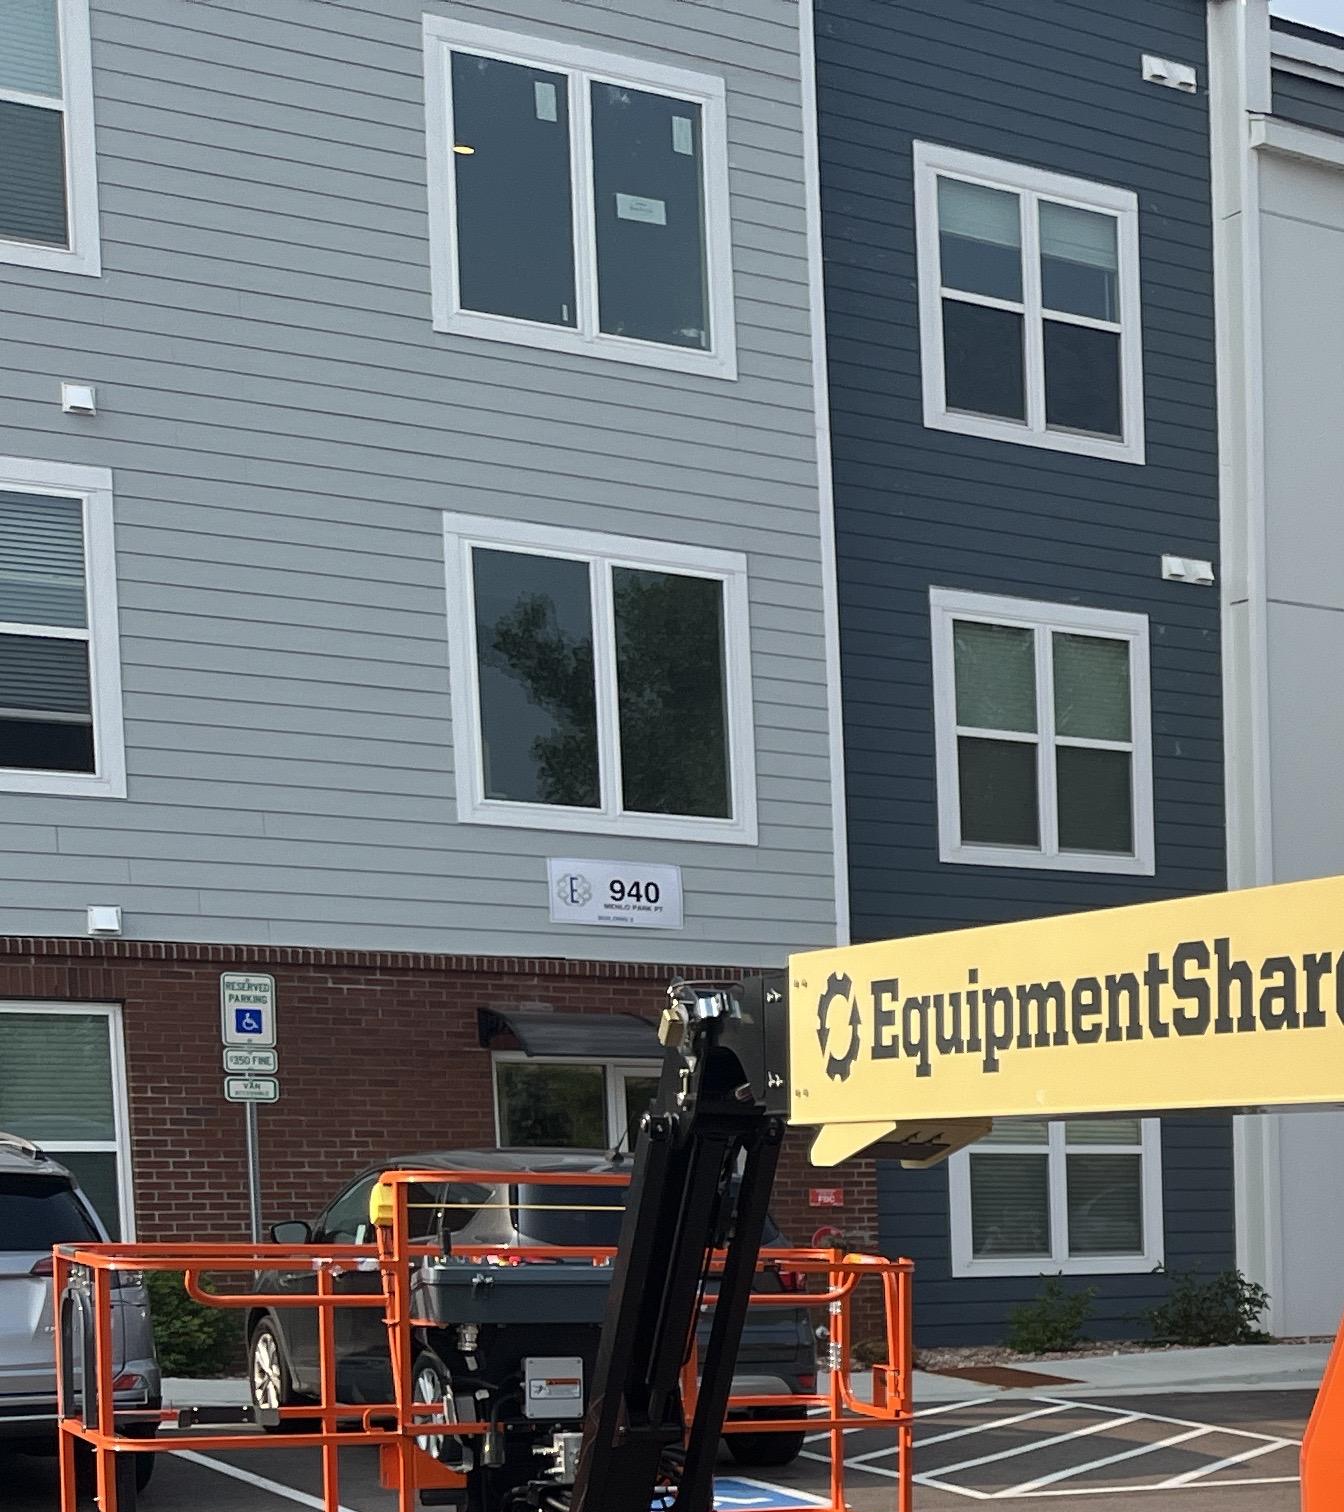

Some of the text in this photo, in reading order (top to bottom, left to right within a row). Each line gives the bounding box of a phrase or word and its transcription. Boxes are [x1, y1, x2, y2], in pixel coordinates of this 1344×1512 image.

[609, 880, 660, 903] 940
[632, 904, 652, 912] PARK
[226, 981, 269, 993] RESERVED
[228, 993, 268, 1004] PARKING
[252, 1056, 273, 1066] FINE
